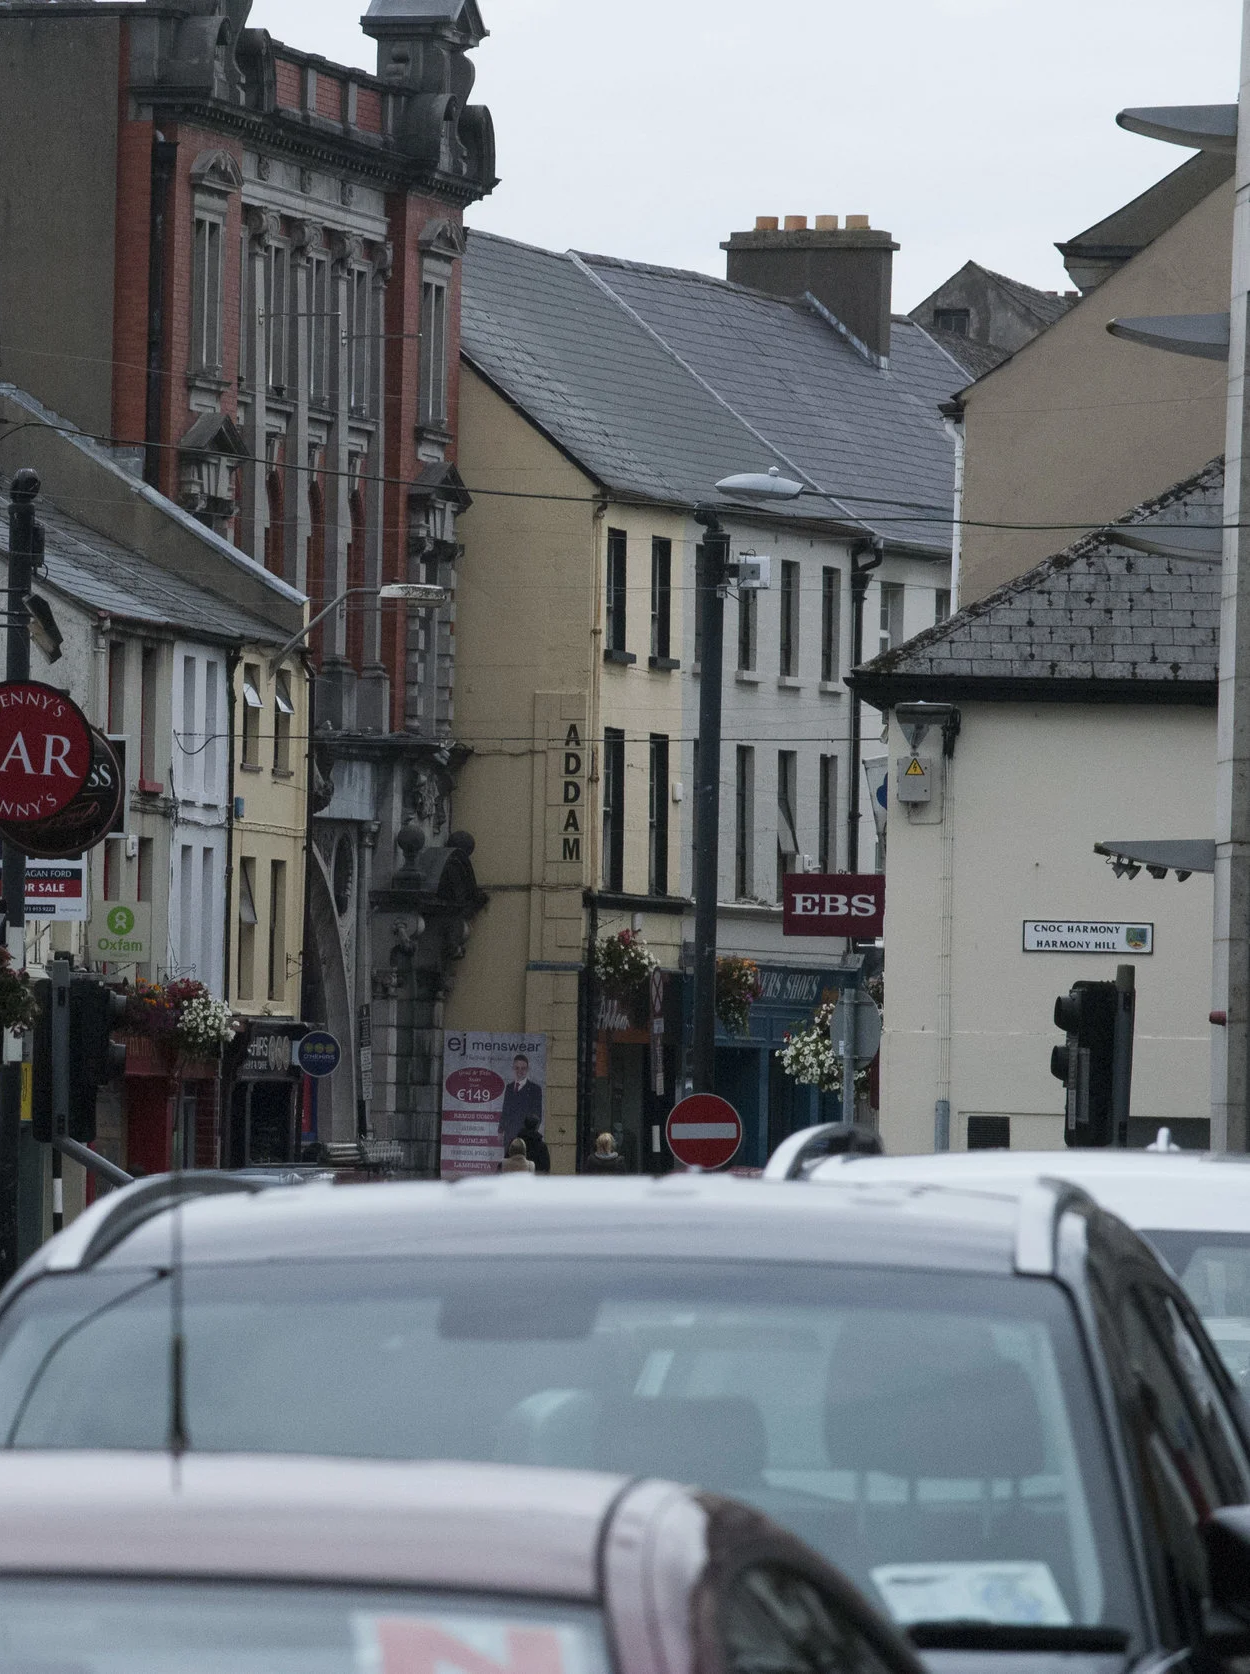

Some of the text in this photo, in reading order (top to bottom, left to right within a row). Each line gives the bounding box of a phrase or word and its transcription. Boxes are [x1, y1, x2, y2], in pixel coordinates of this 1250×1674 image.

[562, 723, 582, 861] ADDAM
[50, 869, 72, 878] FORD
[38, 883, 65, 893] SALE
[791, 893, 876, 917] EBS
[1033, 924, 1121, 935] CNOC HARMONY
[98, 938, 143, 953] Oxfam
[1036, 939, 1117, 950] HARMONY HILL
[783, 973, 821, 1001] SHOES
[447, 1033, 541, 1057] ej menswear
[457, 1088, 491, 1102] €149
